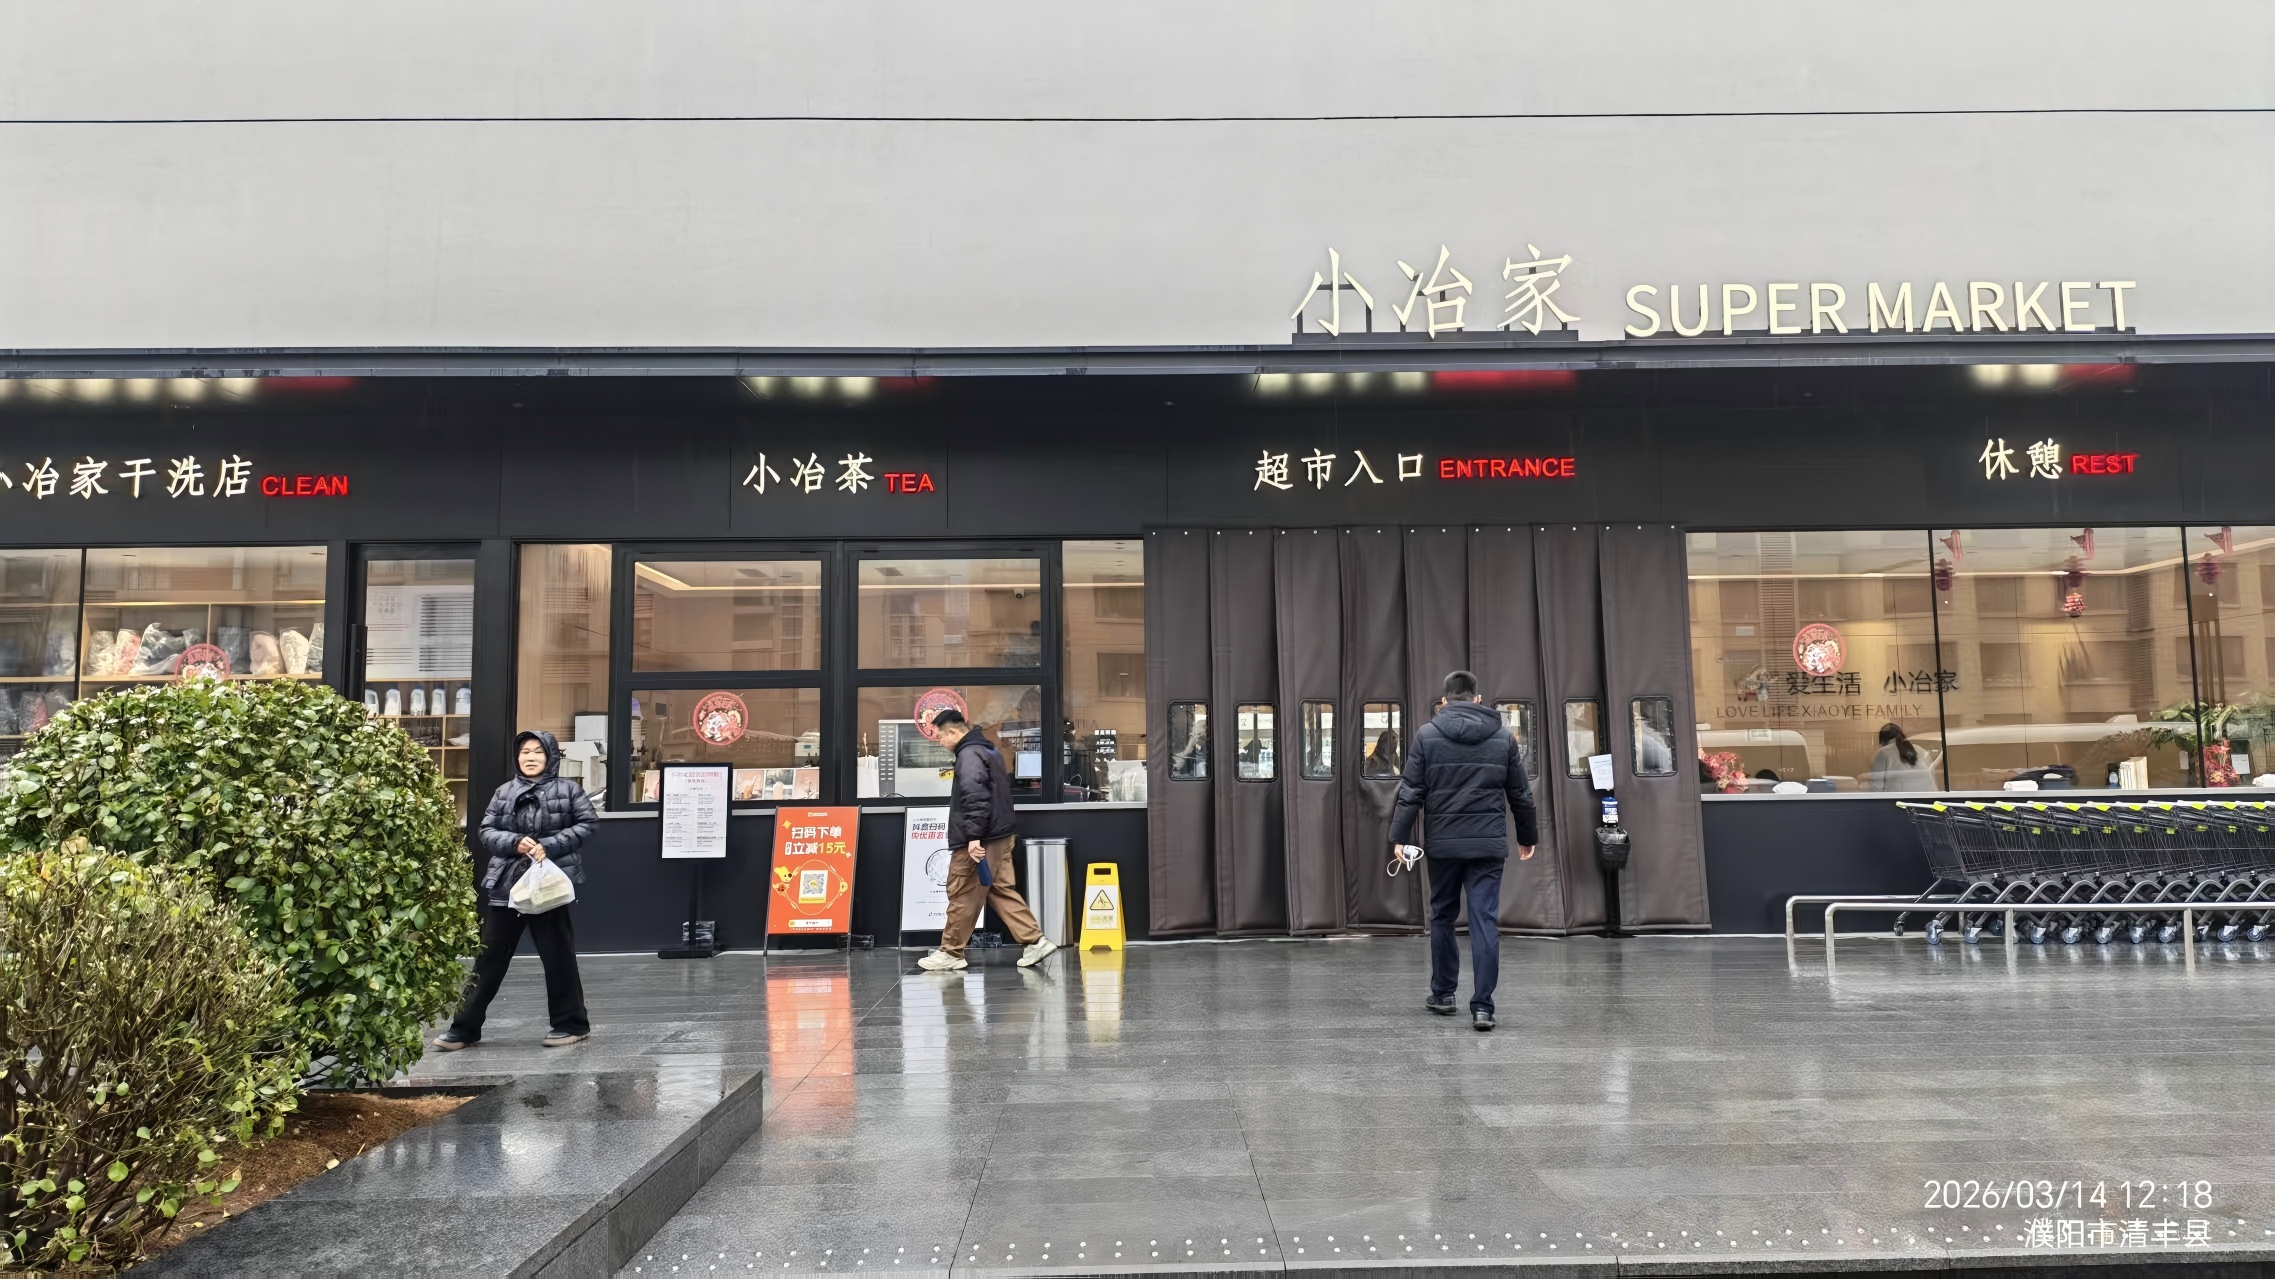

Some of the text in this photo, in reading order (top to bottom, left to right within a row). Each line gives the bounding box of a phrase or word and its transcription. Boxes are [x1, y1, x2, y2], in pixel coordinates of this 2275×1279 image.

[1290, 243, 2136, 339] 小冶家 SUPER MARKET
[1254, 447, 1576, 491] 超市入口 ENTRANCE
[1978, 437, 2138, 481] 休憩 REST
[260, 475, 348, 497] CLEAN
[742, 451, 935, 495] 小冶茶 TEA
[1883, 669, 1959, 696] 小冶家
[1716, 703, 1921, 719] LOVE LIFE XIAOYE FAMILY
[791, 826, 842, 839] 扫码下单
[792, 841, 847, 855] 立减15元
